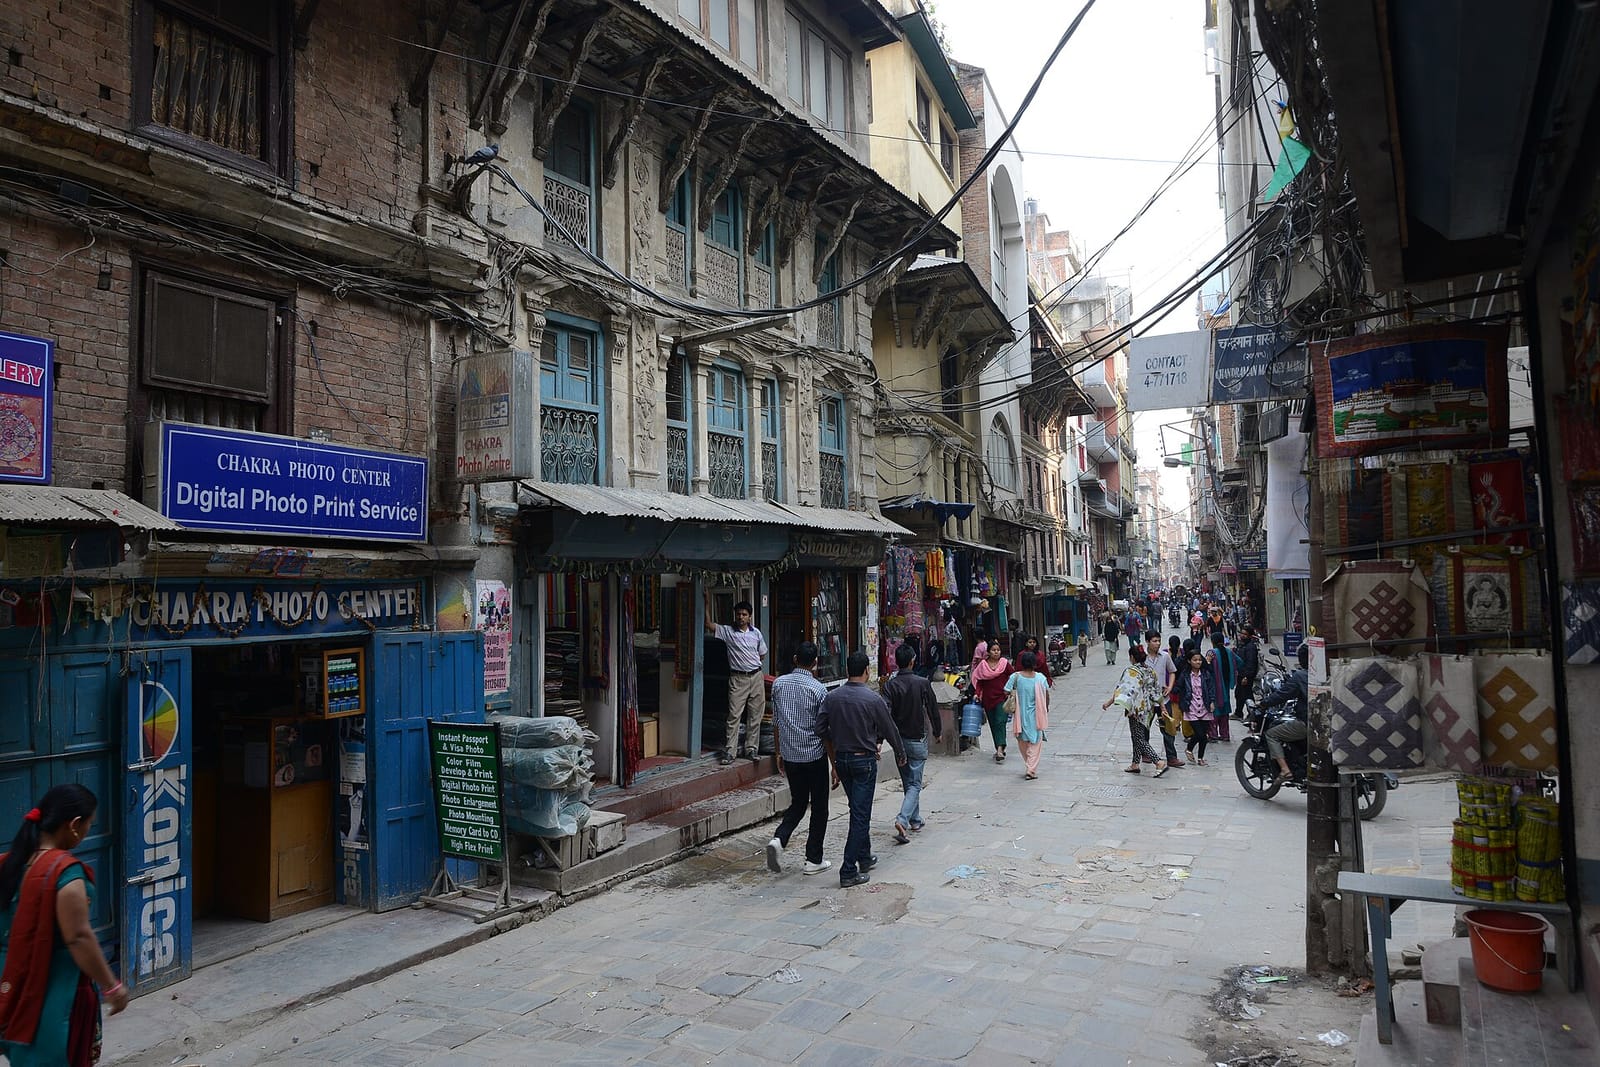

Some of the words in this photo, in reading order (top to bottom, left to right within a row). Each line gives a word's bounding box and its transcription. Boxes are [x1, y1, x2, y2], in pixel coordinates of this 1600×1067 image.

[1146, 355, 1187, 370] CONTACT
[464, 436, 503, 451] CHAKRA
[217, 452, 281, 475] CHAKRA
[288, 461, 335, 482] PHOTO
[342, 467, 391, 487] CENTER
[457, 456, 482, 475] Photo
[484, 453, 511, 472] Centre
[176, 481, 245, 513] Digital
[251, 488, 308, 514] Photo
[313, 494, 355, 518] Print
[359, 498, 418, 522] Service
[132, 591, 250, 626] CHAKRA
[257, 590, 328, 622] PHOTO
[339, 588, 418, 619] CENTER
[487, 647, 503, 658] Selling
[438, 732, 461, 742] Instant
[462, 734, 489, 746] Passport
[442, 742, 448, 751] &
[449, 743, 464, 753] Visa
[465, 744, 484, 754] Photo
[446, 756, 463, 766] Color
[465, 758, 482, 768] Film
[440, 765, 466, 778] Develop
[467, 768, 473, 777] &
[474, 769, 493, 779] Print
[441, 779, 461, 791] Digital
[461, 781, 480, 792] Photo
[481, 782, 496, 793] Print
[442, 794, 461, 804] Photo
[448, 808, 465, 819] Photo
[465, 811, 494, 825] Mounting
[444, 822, 467, 837] Memory
[468, 825, 482, 837] Card
[482, 828, 489, 838] to
[490, 829, 499, 840] CD
[450, 840, 464, 852] High
[464, 841, 477, 852] Flex
[478, 843, 494, 855] Print
[139, 764, 187, 977] Konica
